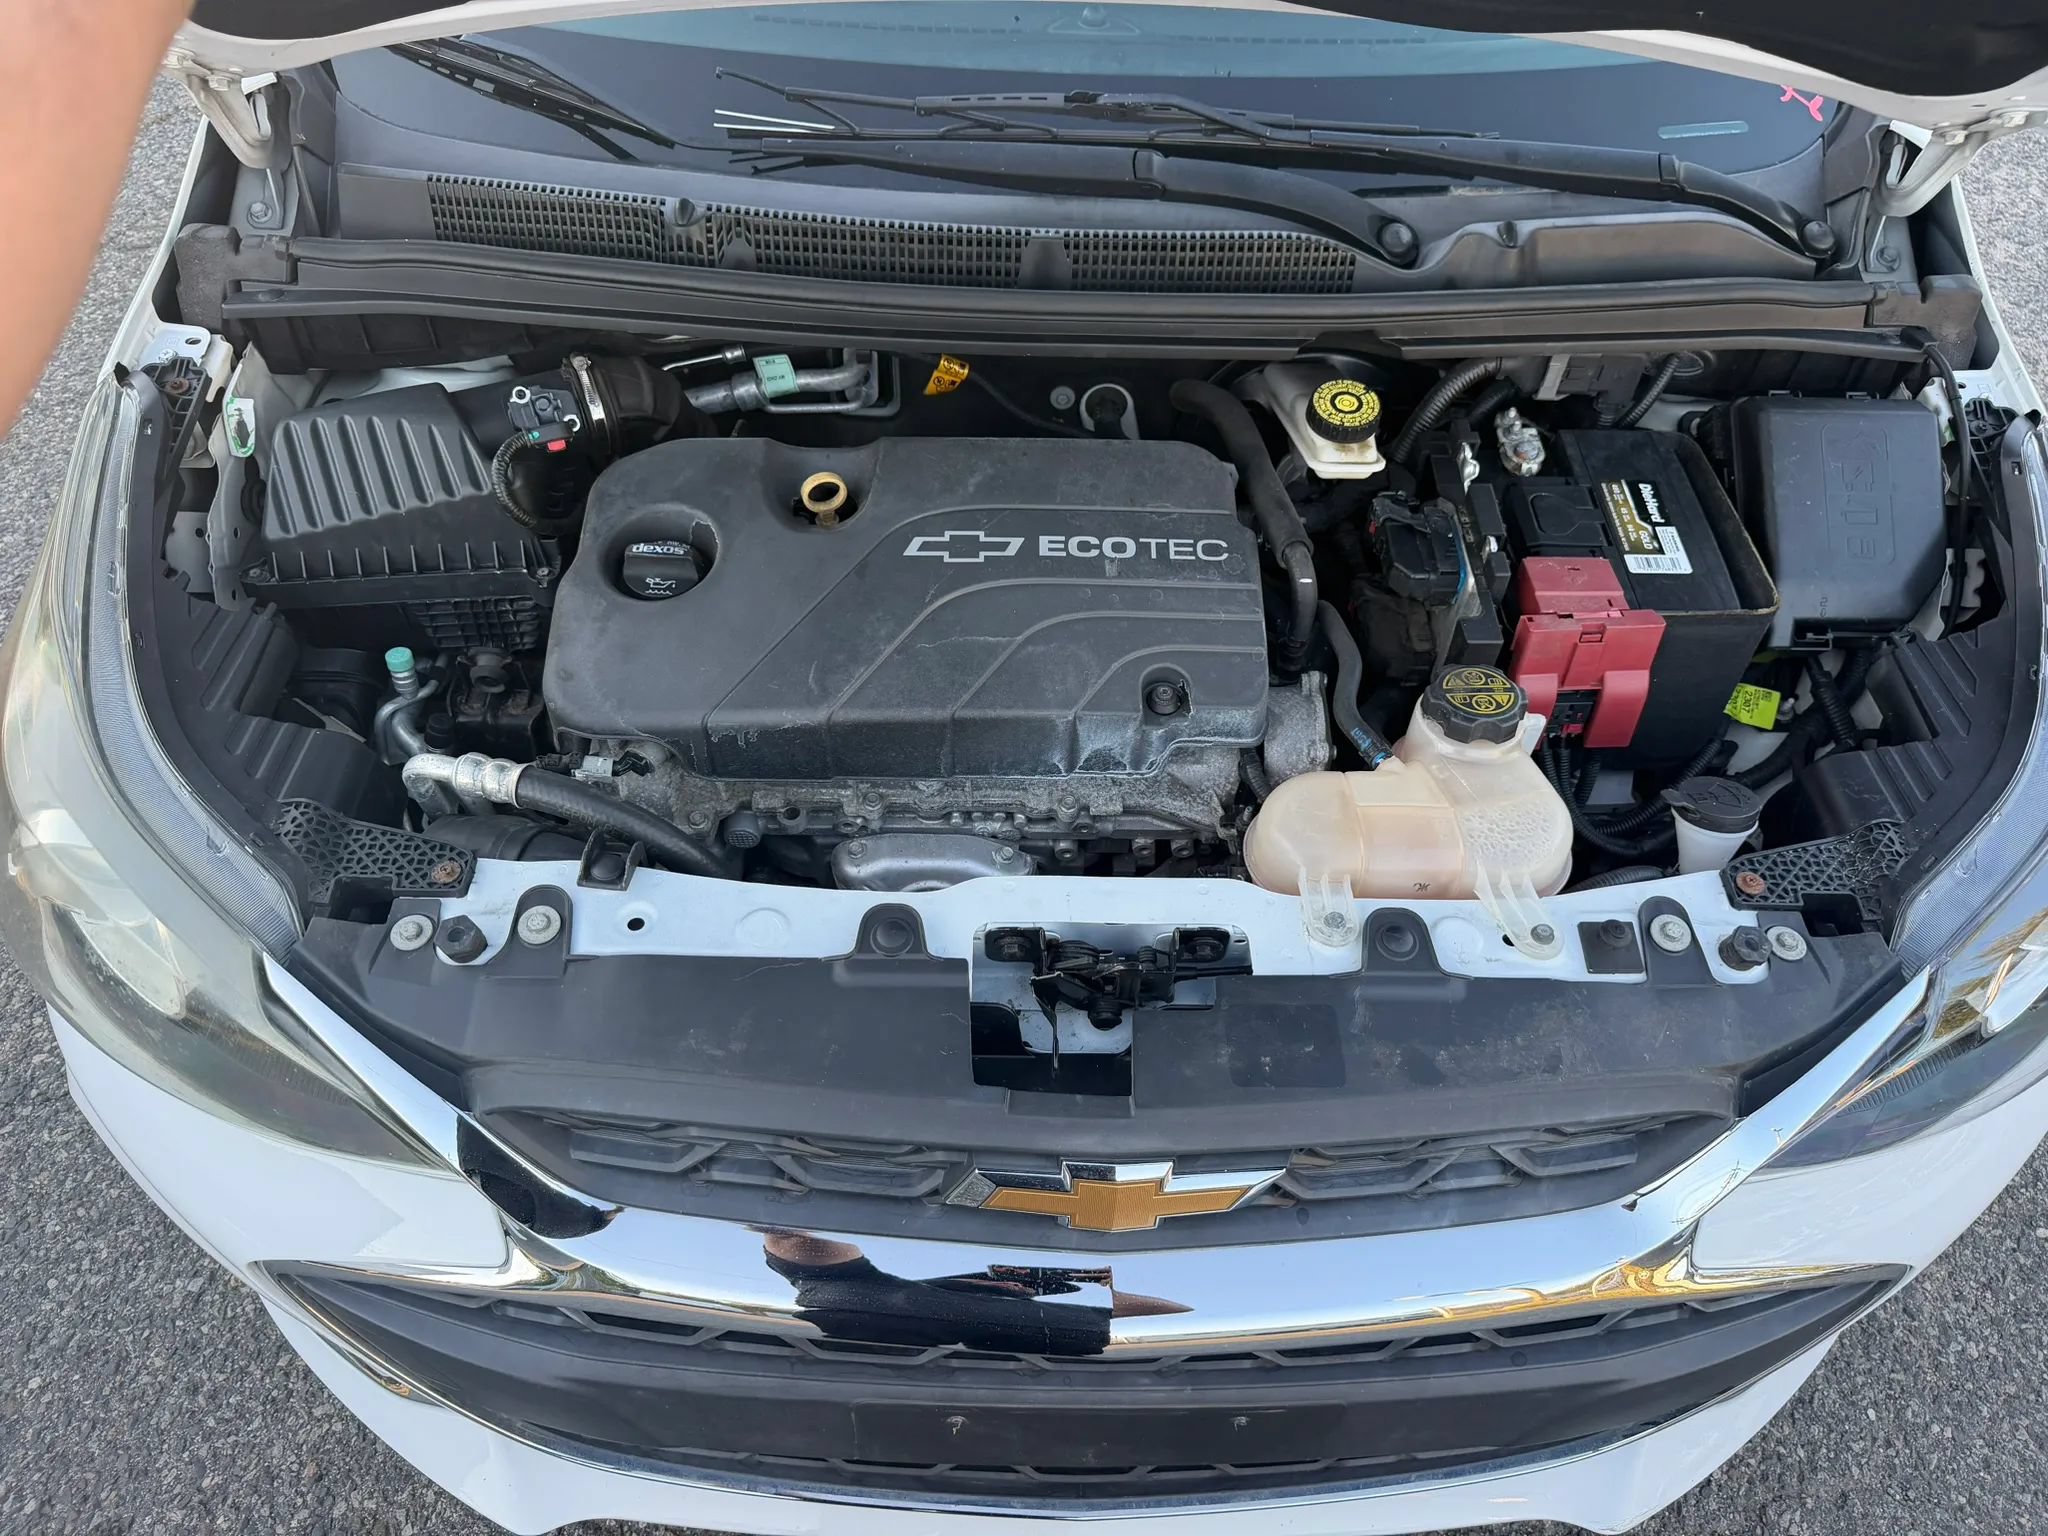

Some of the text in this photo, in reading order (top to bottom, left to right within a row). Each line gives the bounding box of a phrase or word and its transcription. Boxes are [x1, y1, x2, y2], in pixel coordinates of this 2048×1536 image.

[1638, 483, 1665, 523] DieHard
[631, 542, 685, 555] dexos
[1038, 535, 1229, 561] ECOTEC
[1638, 530, 1654, 550] GOLD
[1742, 690, 1754, 714] 2307
